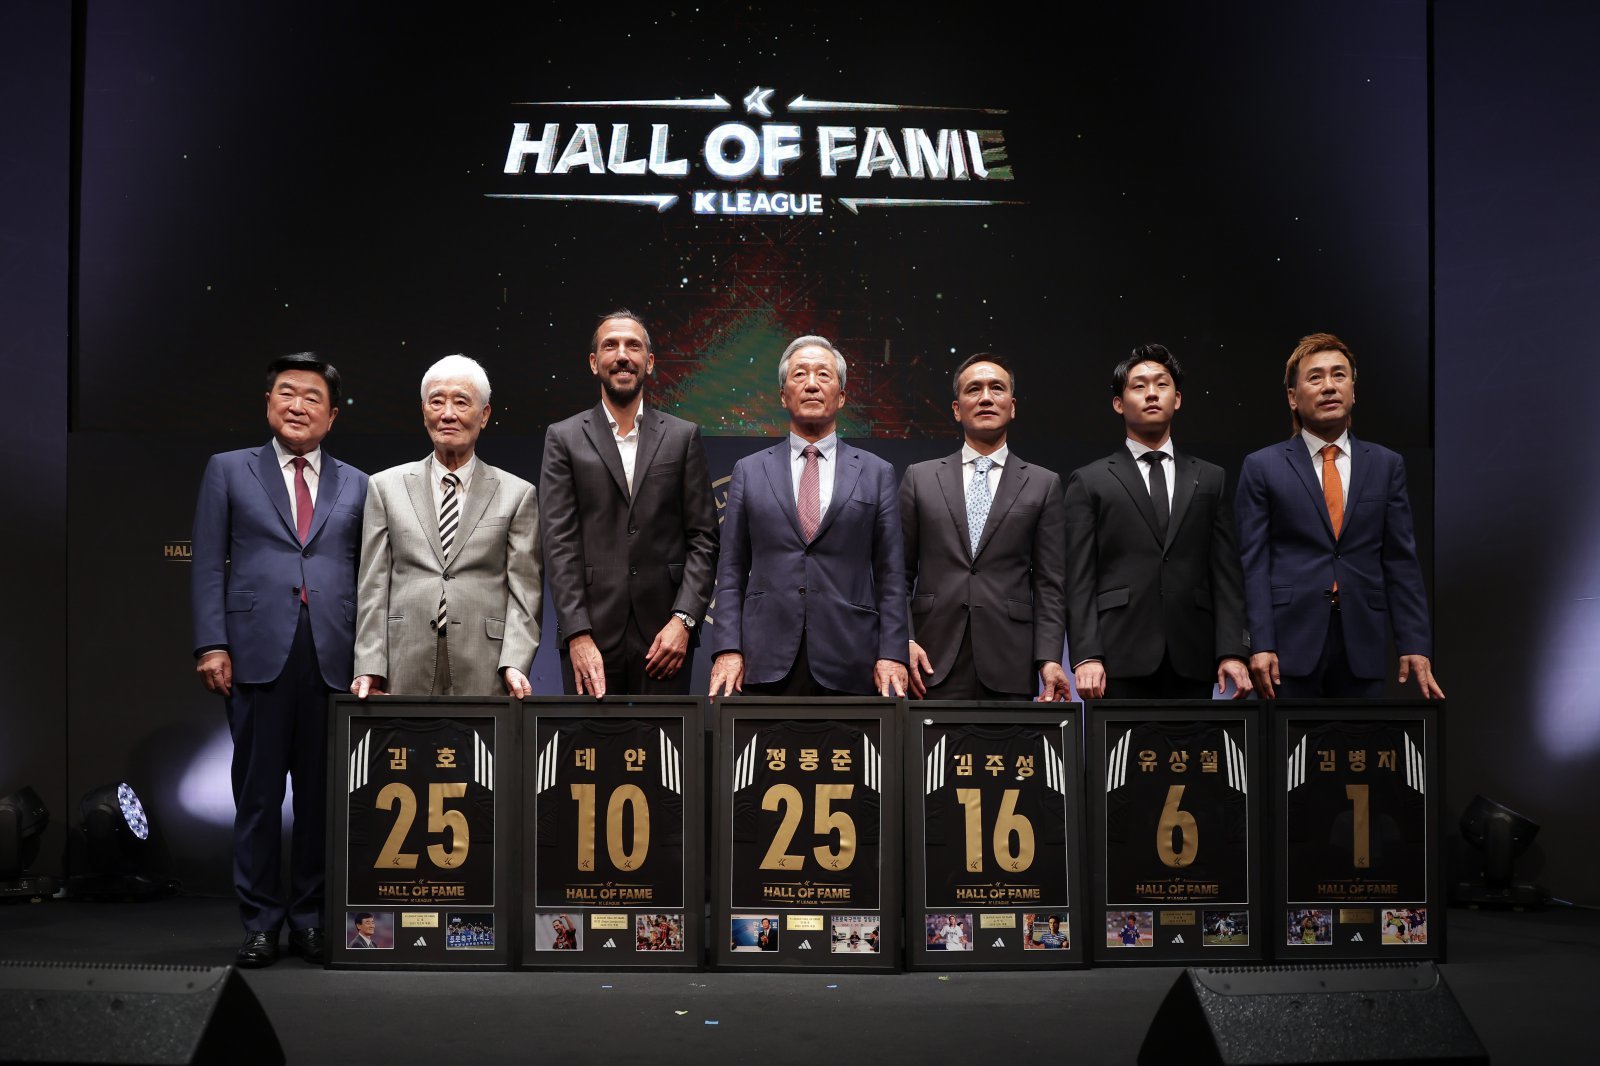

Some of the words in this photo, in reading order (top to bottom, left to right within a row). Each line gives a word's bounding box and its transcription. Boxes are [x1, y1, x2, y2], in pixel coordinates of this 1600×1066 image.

[504, 122, 688, 175] HALL
[704, 121, 801, 178] OF
[817, 126, 1014, 180] FAME
[693, 191, 717, 214] K
[721, 192, 824, 214] LEAGUE
[164, 545, 193, 557] HAL
[373, 782, 470, 869] 25
[570, 783, 651, 872] 10
[758, 783, 857, 871] 25
[955, 787, 1036, 873] 16
[1156, 784, 1199, 868] 6
[1345, 784, 1370, 868] 1
[378, 885, 409, 897] HALL
[411, 886, 429, 897] OF
[431, 885, 465, 897] FAME
[566, 888, 597, 899] HALL
[599, 888, 617, 900] OF
[619, 888, 653, 899] FAME
[763, 886, 795, 898] HALL
[797, 887, 815, 899] OF
[817, 888, 851, 899] FAME
[956, 888, 987, 899] HALL
[989, 888, 1006, 899] OF
[1008, 888, 1041, 899] FAME
[1135, 884, 1166, 894] HALL
[1168, 884, 1185, 895] OF
[1186, 884, 1219, 895] FAME
[1317, 884, 1347, 894] HALL
[1348, 884, 1365, 895] OF
[1366, 884, 1399, 894] FAME
